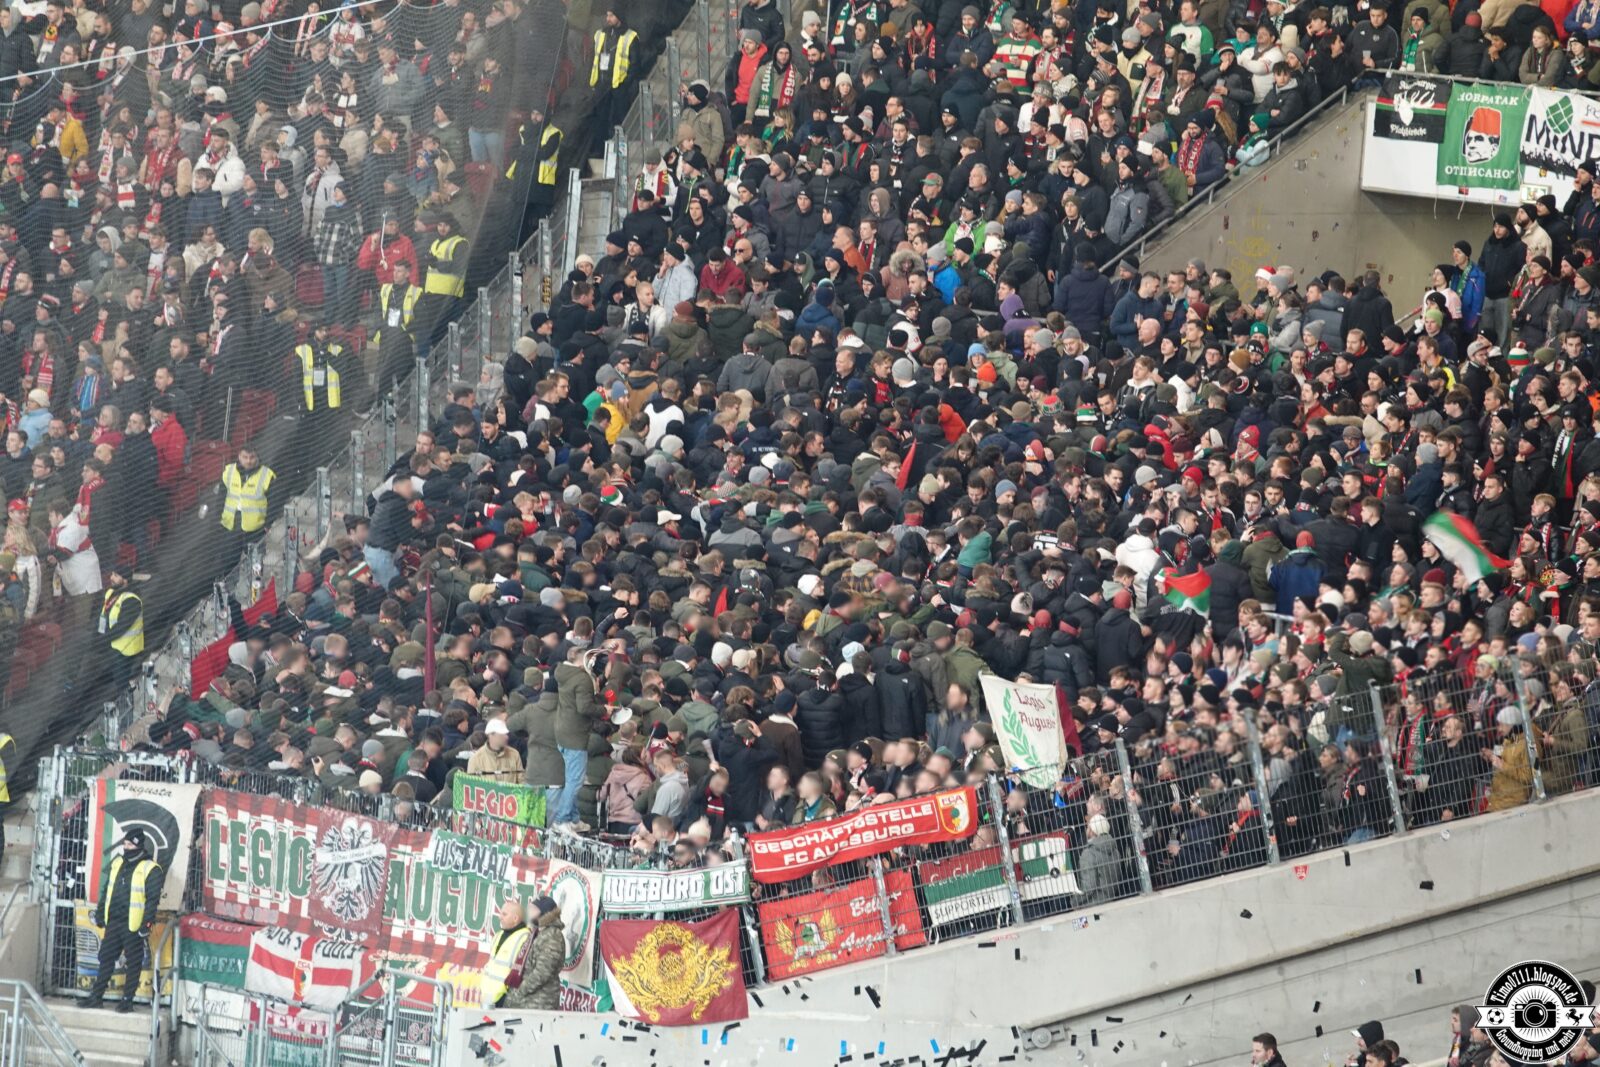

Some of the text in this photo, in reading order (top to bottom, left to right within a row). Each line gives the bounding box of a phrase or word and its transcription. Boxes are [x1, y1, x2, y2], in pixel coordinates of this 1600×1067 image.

[462, 784, 518, 820] LEGIO
[206, 816, 315, 899] LEGIO
[431, 836, 513, 884] LUSTENAU
[783, 851, 808, 866] FC
[602, 873, 704, 905] AUGSBURG
[709, 866, 747, 899] OST
